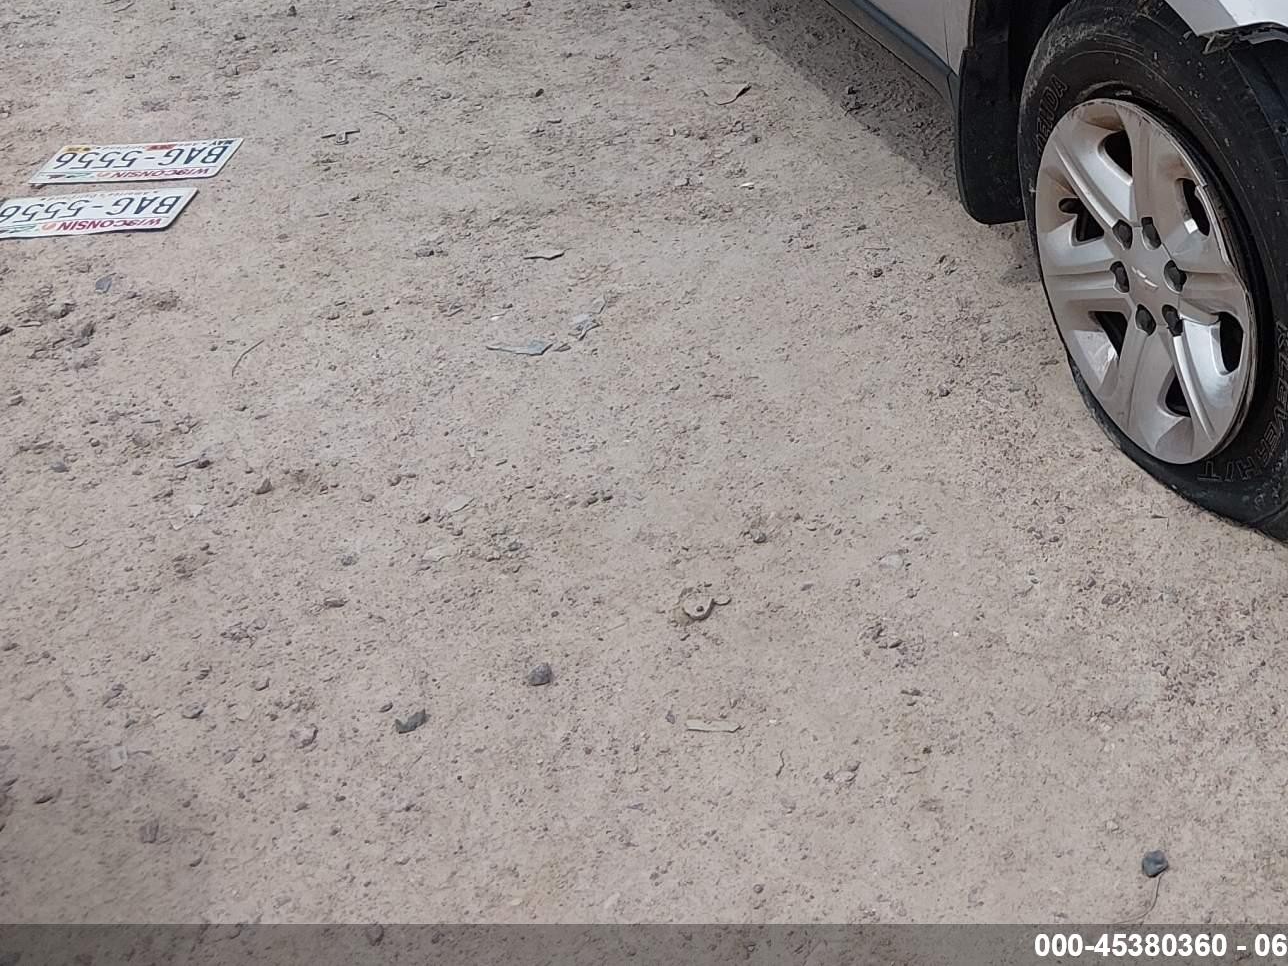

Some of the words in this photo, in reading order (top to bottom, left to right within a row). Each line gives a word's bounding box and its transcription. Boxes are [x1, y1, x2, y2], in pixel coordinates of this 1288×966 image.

[55, 145, 222, 169] BAG-5556
[113, 168, 209, 178] WISCONSIN
[0, 196, 181, 223] BAG-5556
[59, 219, 161, 231] WISCONSIN
